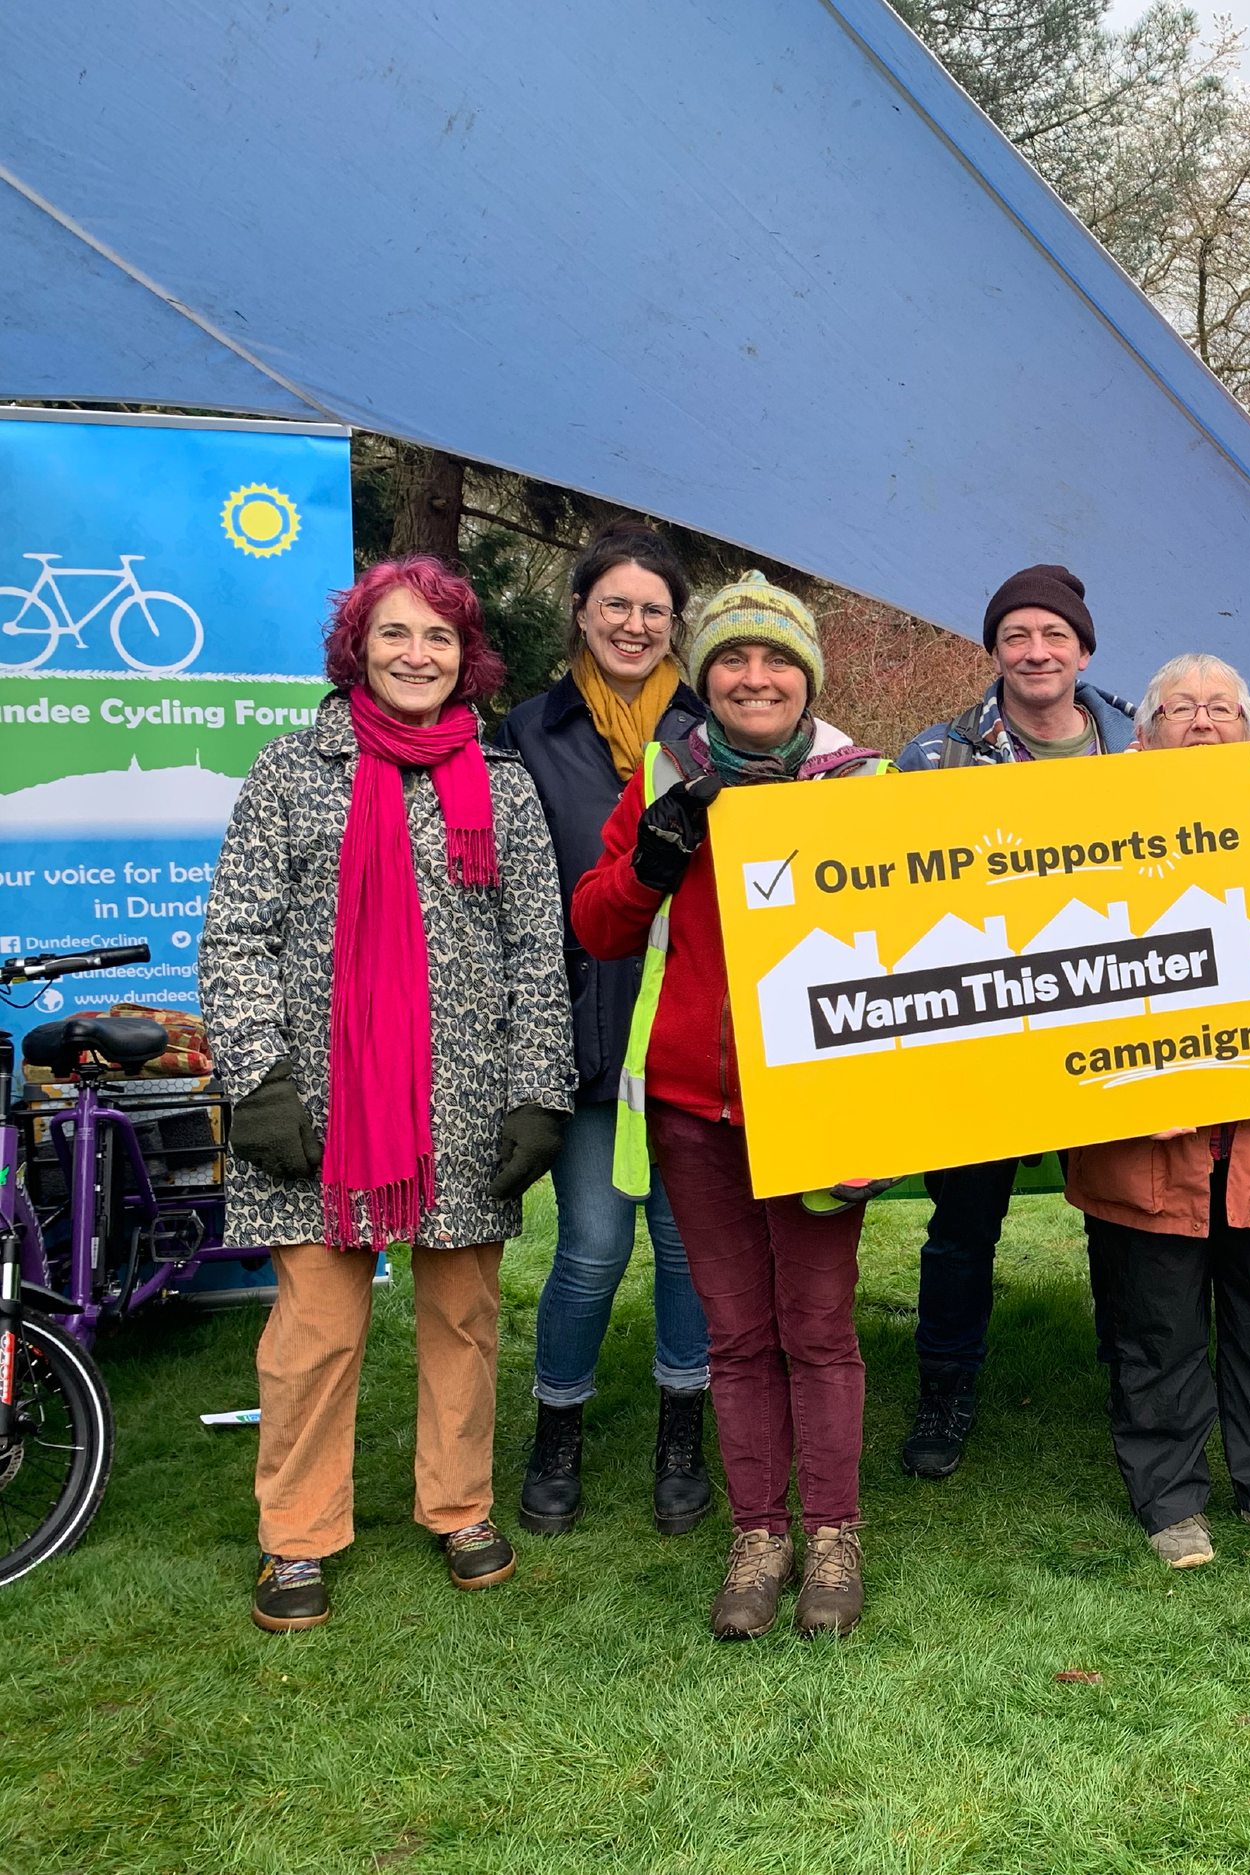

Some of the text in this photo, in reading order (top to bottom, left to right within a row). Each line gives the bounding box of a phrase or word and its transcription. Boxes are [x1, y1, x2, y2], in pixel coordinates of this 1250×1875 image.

[0, 697, 318, 729] ndee Cycling Foru
[814, 822, 1240, 894] Our MP supports the
[0, 870, 36, 886] ur
[44, 864, 116, 885] voice
[123, 862, 162, 884] for
[94, 895, 207, 919] in Dund
[26, 934, 148, 950] DundeeCycling
[817, 946, 1209, 1035] Warm This Winter
